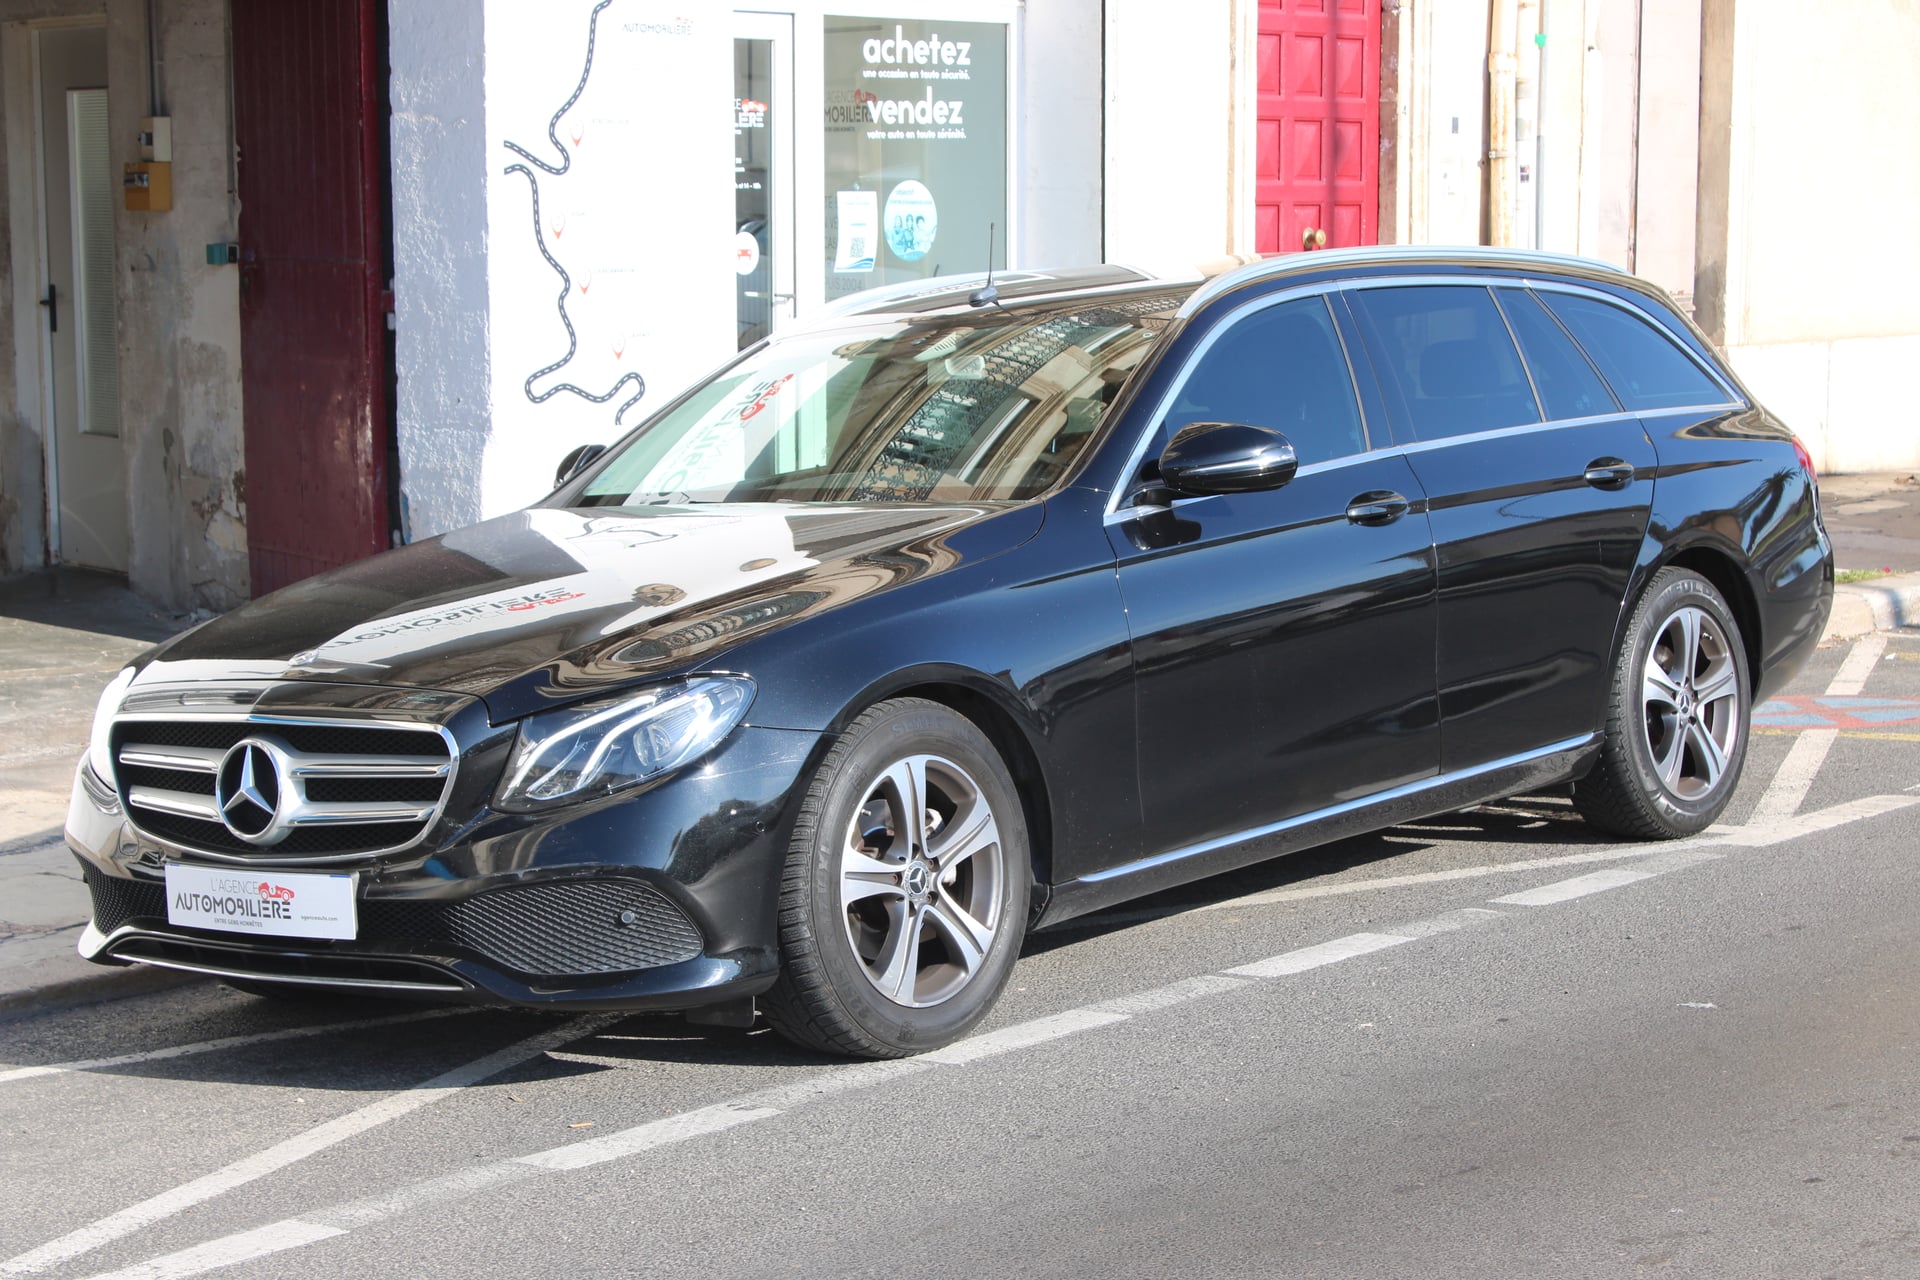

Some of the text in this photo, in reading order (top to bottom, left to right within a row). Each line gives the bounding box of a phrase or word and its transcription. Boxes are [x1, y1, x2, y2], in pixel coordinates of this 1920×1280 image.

[863, 25, 971, 65] achetez
[862, 70, 877, 78] une
[878, 68, 908, 79] occasion
[867, 86, 963, 124] vendez
[887, 130, 904, 139] auto
[210, 878, 259, 895] L'AGENCE
